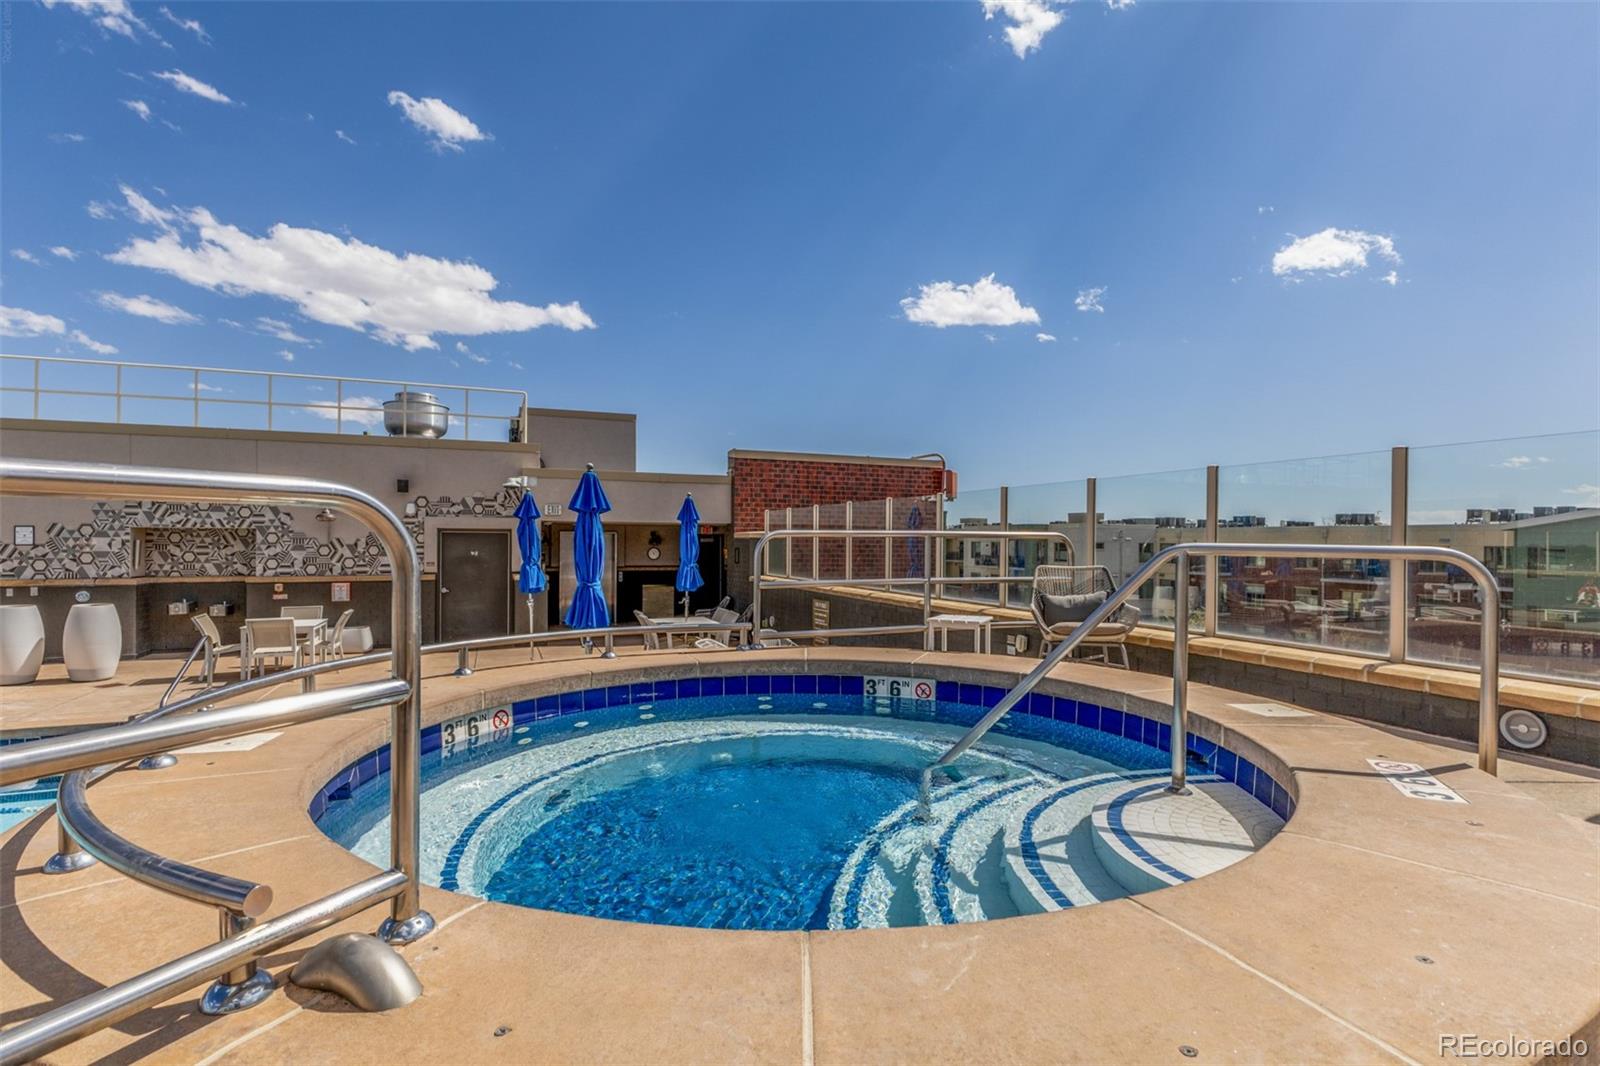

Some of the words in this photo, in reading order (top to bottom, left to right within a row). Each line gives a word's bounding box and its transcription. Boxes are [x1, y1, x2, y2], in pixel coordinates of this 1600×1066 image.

[866, 679, 877, 695] 3
[890, 681, 901, 696] 6
[445, 724, 455, 744] 3
[467, 717, 479, 736] 6
